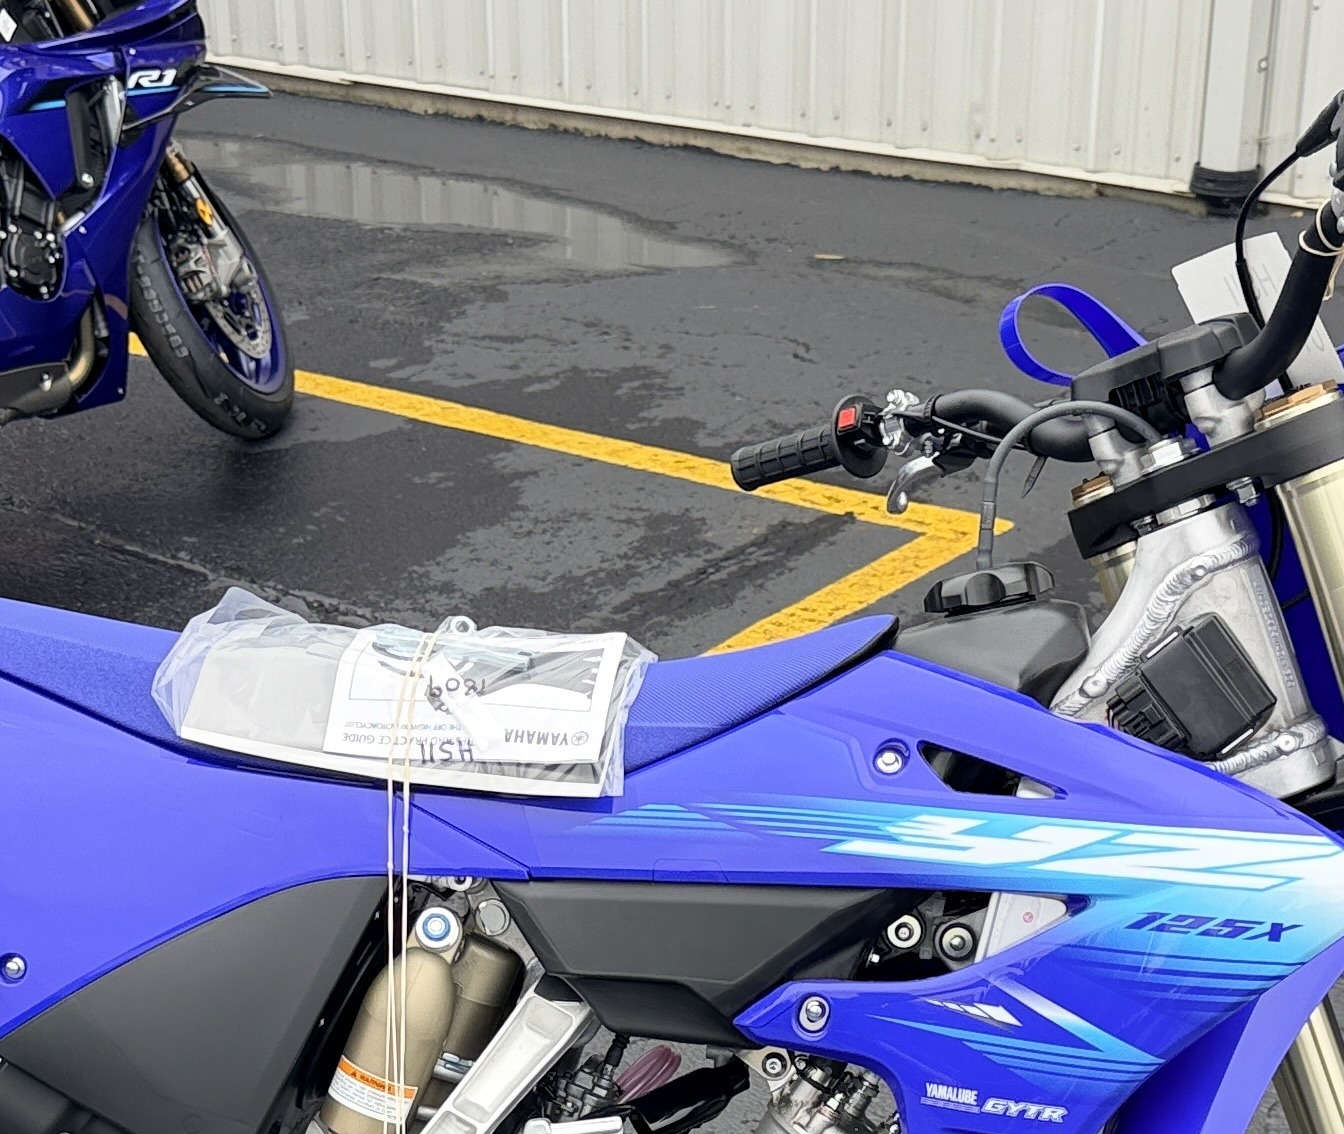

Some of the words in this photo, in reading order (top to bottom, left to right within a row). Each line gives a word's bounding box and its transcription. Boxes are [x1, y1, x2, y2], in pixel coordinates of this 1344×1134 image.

[127, 69, 177, 89] R1
[341, 732, 375, 745] GUIDE
[377, 735, 427, 747] PRACTCE
[505, 728, 568, 746] YAMAHA
[1124, 911, 1307, 943] 125X
[925, 1082, 979, 1106] YAMALUBE
[980, 1097, 1068, 1124] GYTR
